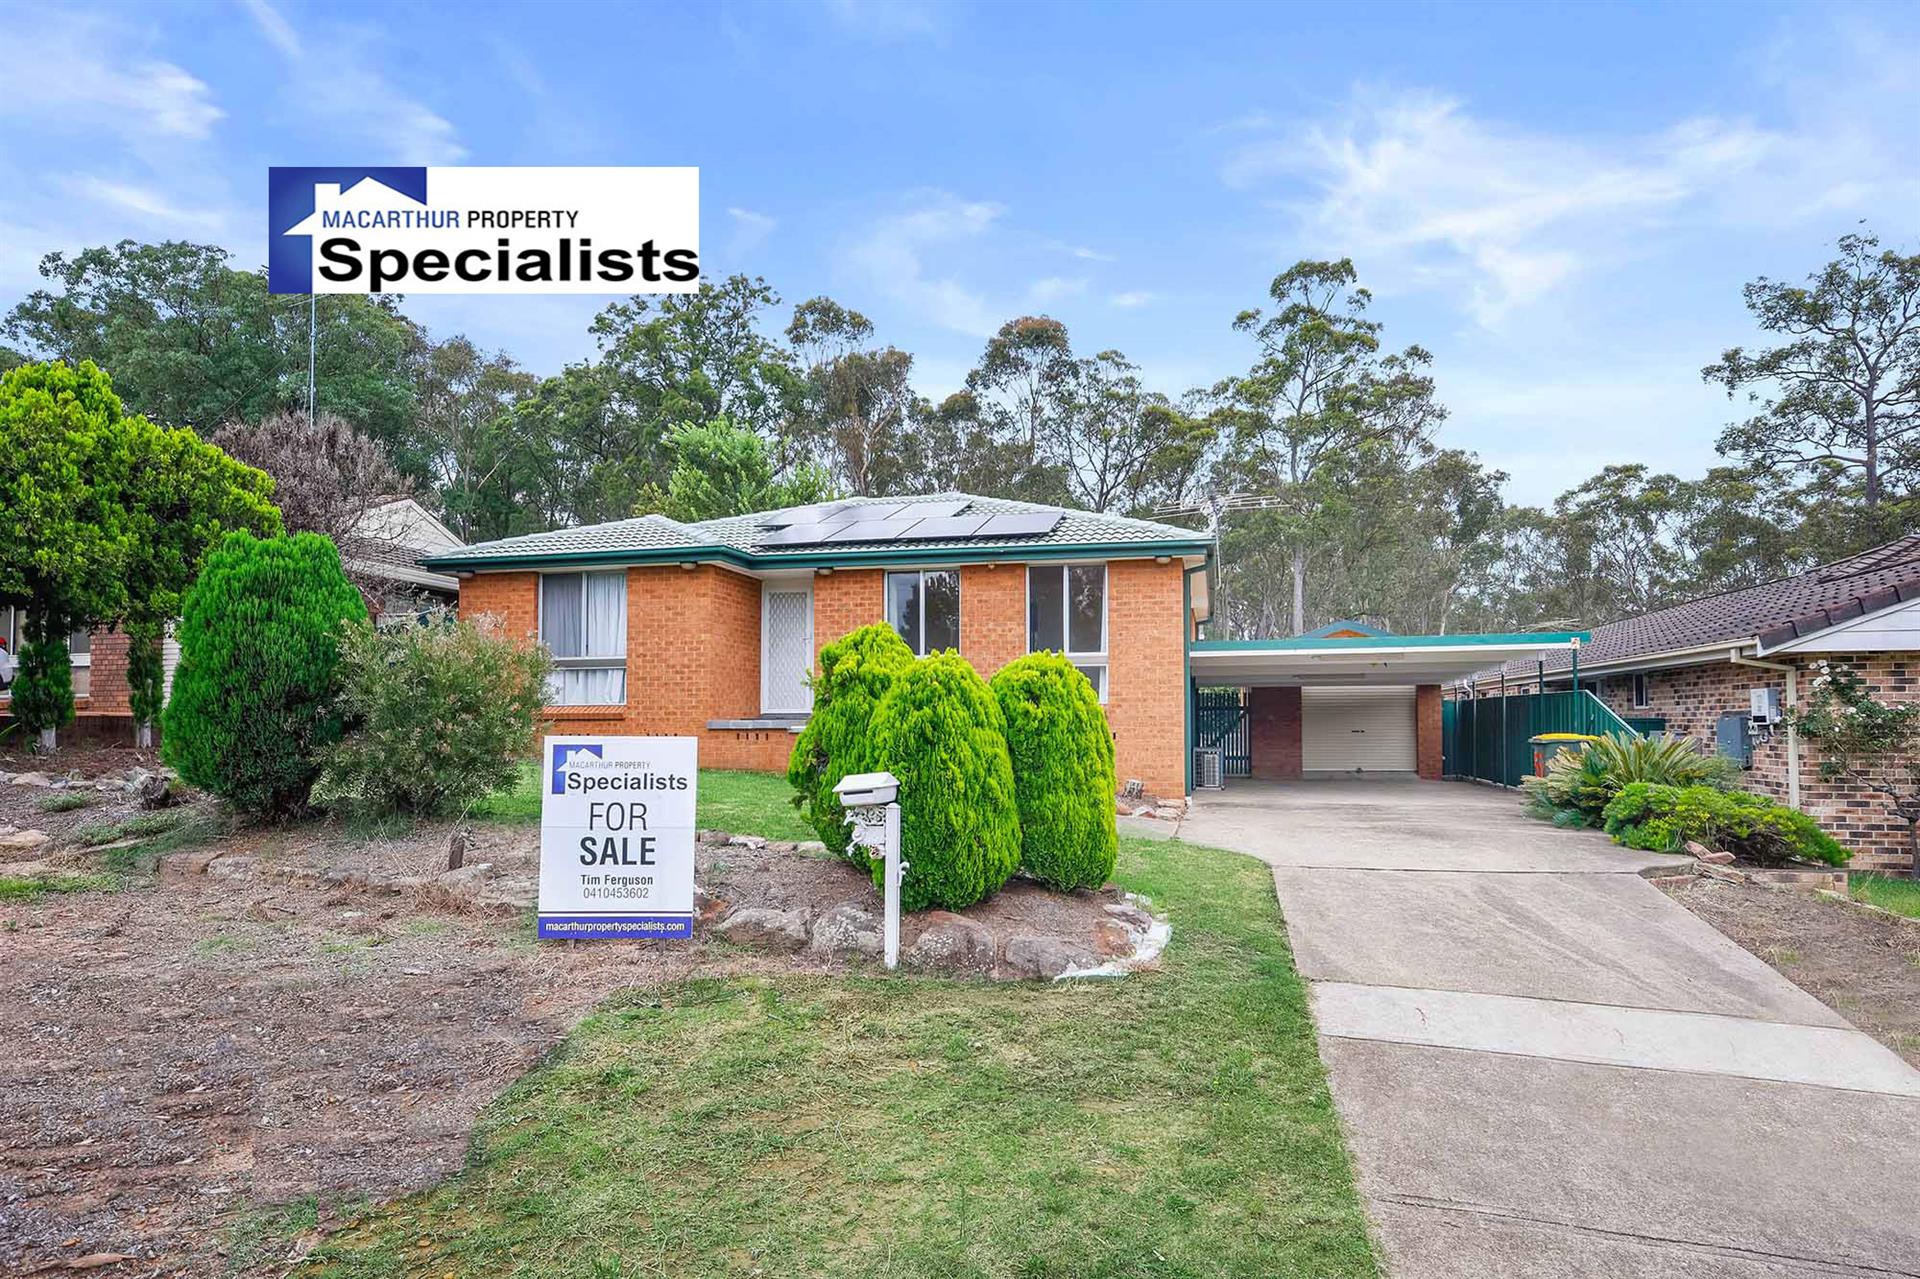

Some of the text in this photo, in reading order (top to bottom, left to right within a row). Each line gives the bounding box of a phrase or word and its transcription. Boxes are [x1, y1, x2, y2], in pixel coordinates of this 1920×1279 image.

[569, 761, 650, 769] MACARTHUR PROPERTY
[568, 772, 688, 793] Specialists
[589, 802, 647, 831] FOR
[580, 837, 656, 865] SALE
[581, 875, 653, 887] Tim Ferguson
[583, 888, 649, 898] 0410453602
[545, 922, 685, 933] macarthurpropertyspecialists.com
